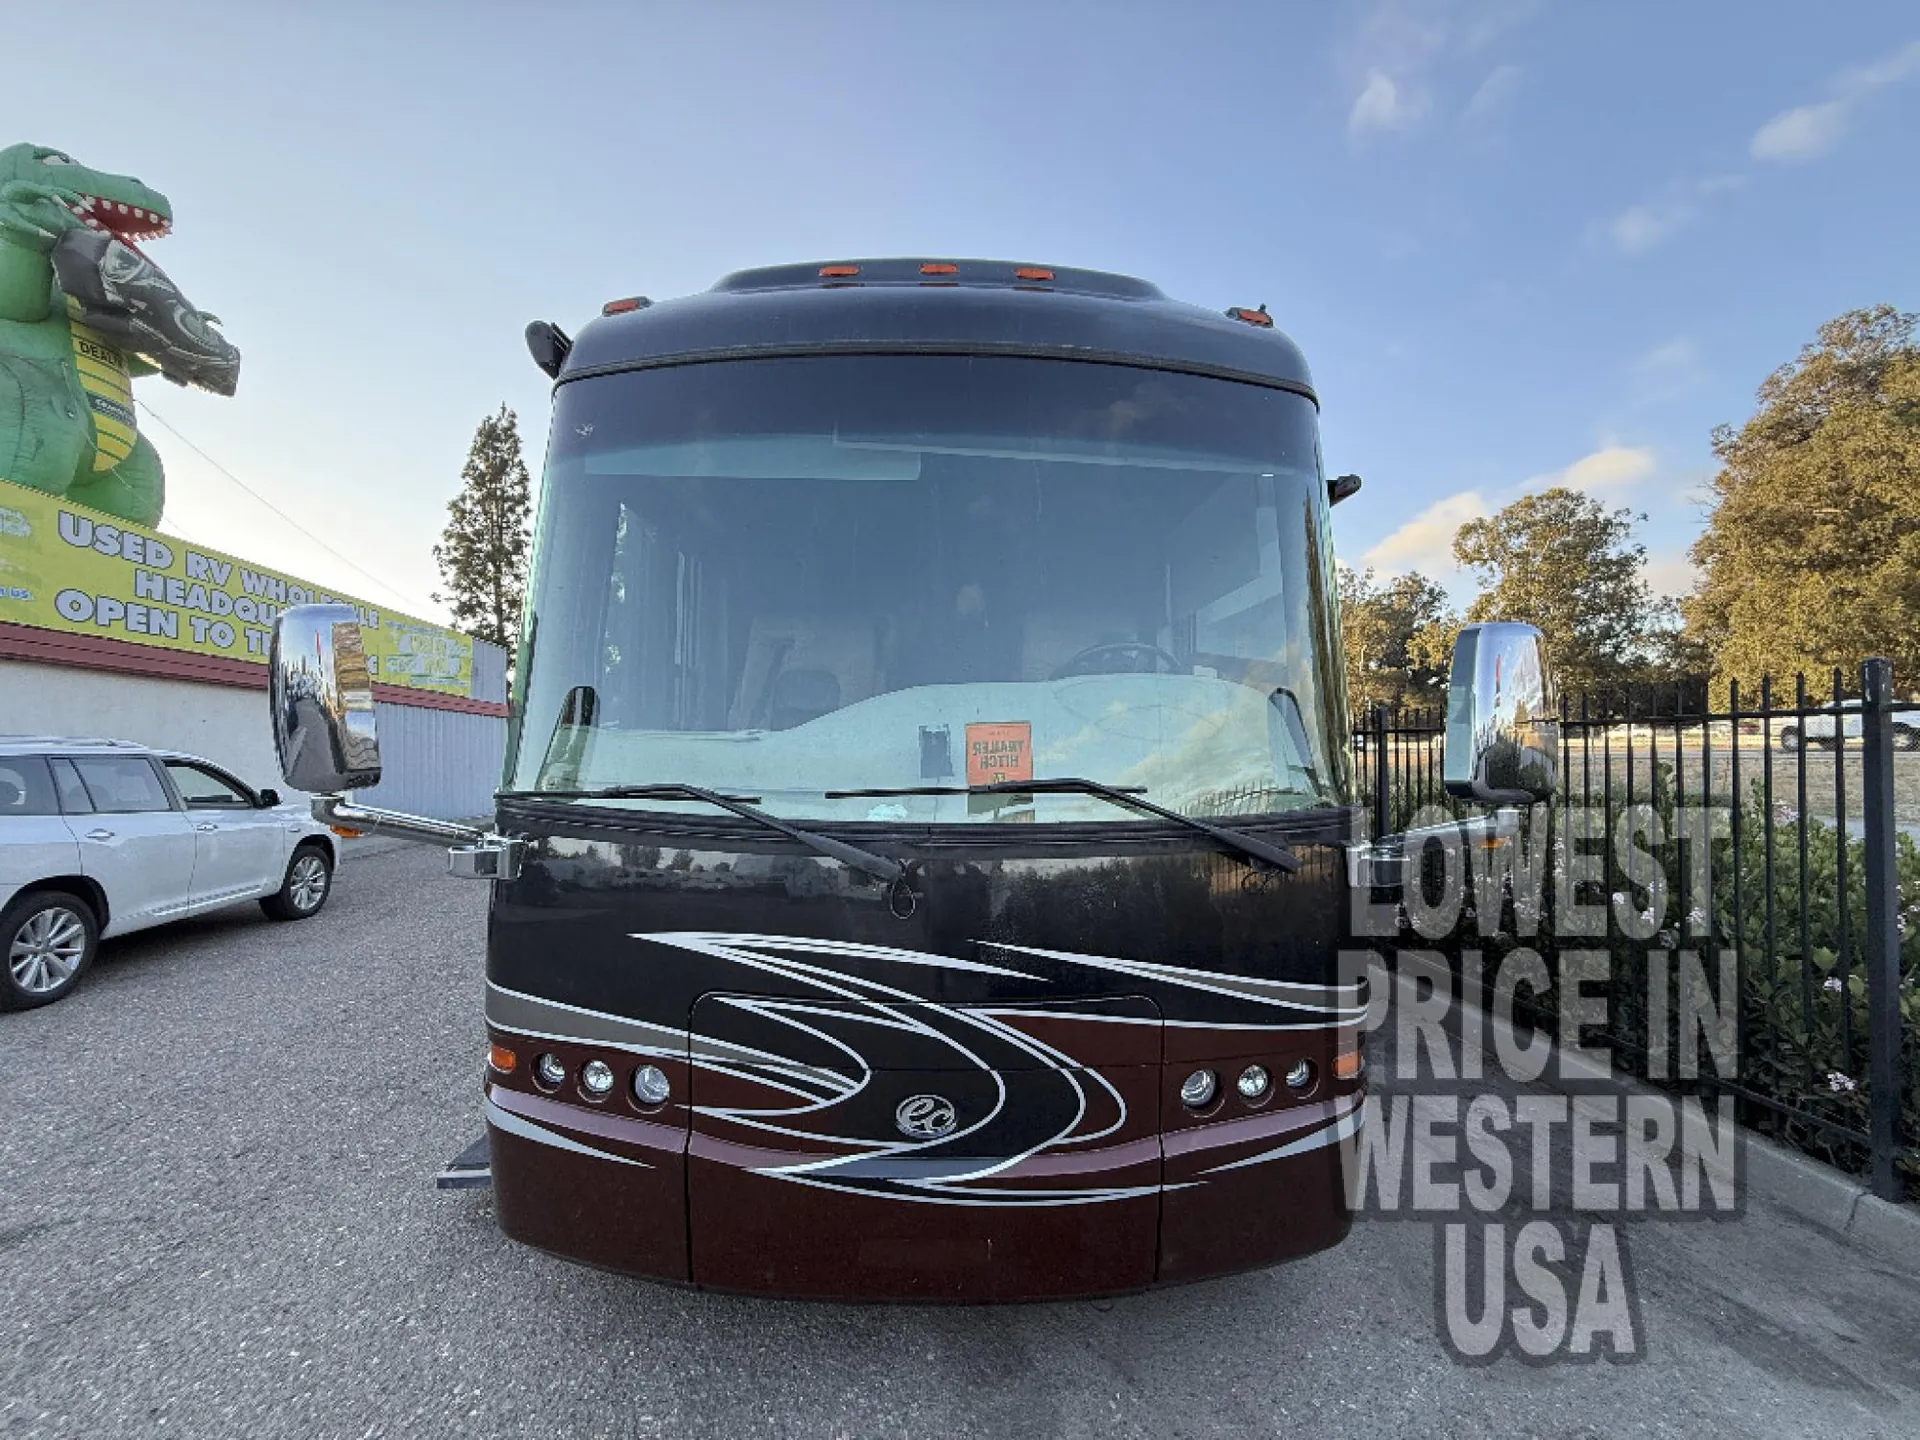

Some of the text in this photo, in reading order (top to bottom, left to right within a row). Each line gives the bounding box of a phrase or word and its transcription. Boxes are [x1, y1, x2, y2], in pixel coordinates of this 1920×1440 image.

[58, 510, 174, 570] USED
[185, 549, 234, 587] RV
[54, 588, 179, 640] OPEN
[189, 615, 237, 649] TO
